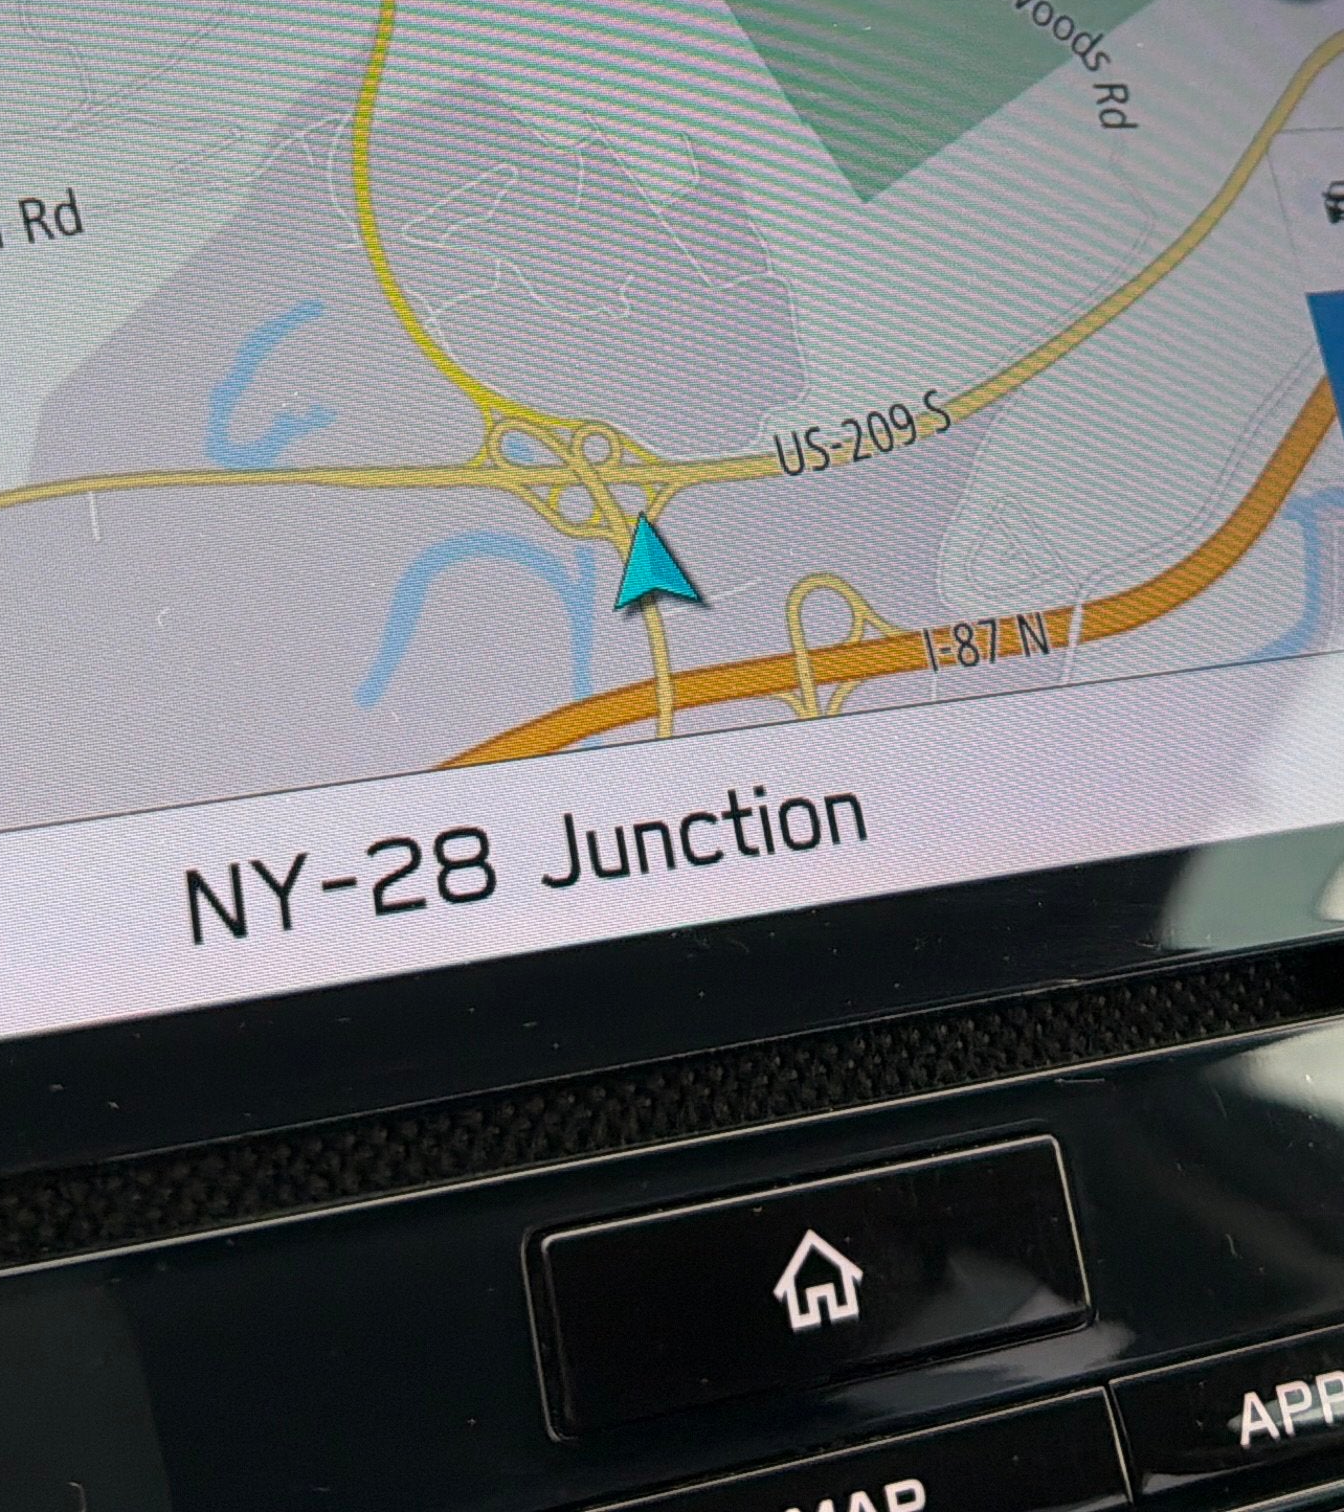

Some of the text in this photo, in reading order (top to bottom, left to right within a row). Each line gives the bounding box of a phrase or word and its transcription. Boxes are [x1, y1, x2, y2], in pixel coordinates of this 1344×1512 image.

[1092, 80, 1139, 131] Rd
[18, 186, 86, 244] Rd
[772, 388, 952, 477] US-209 S
[923, 611, 1051, 674] I-87 N
[182, 783, 870, 947] NY-28 Junction
